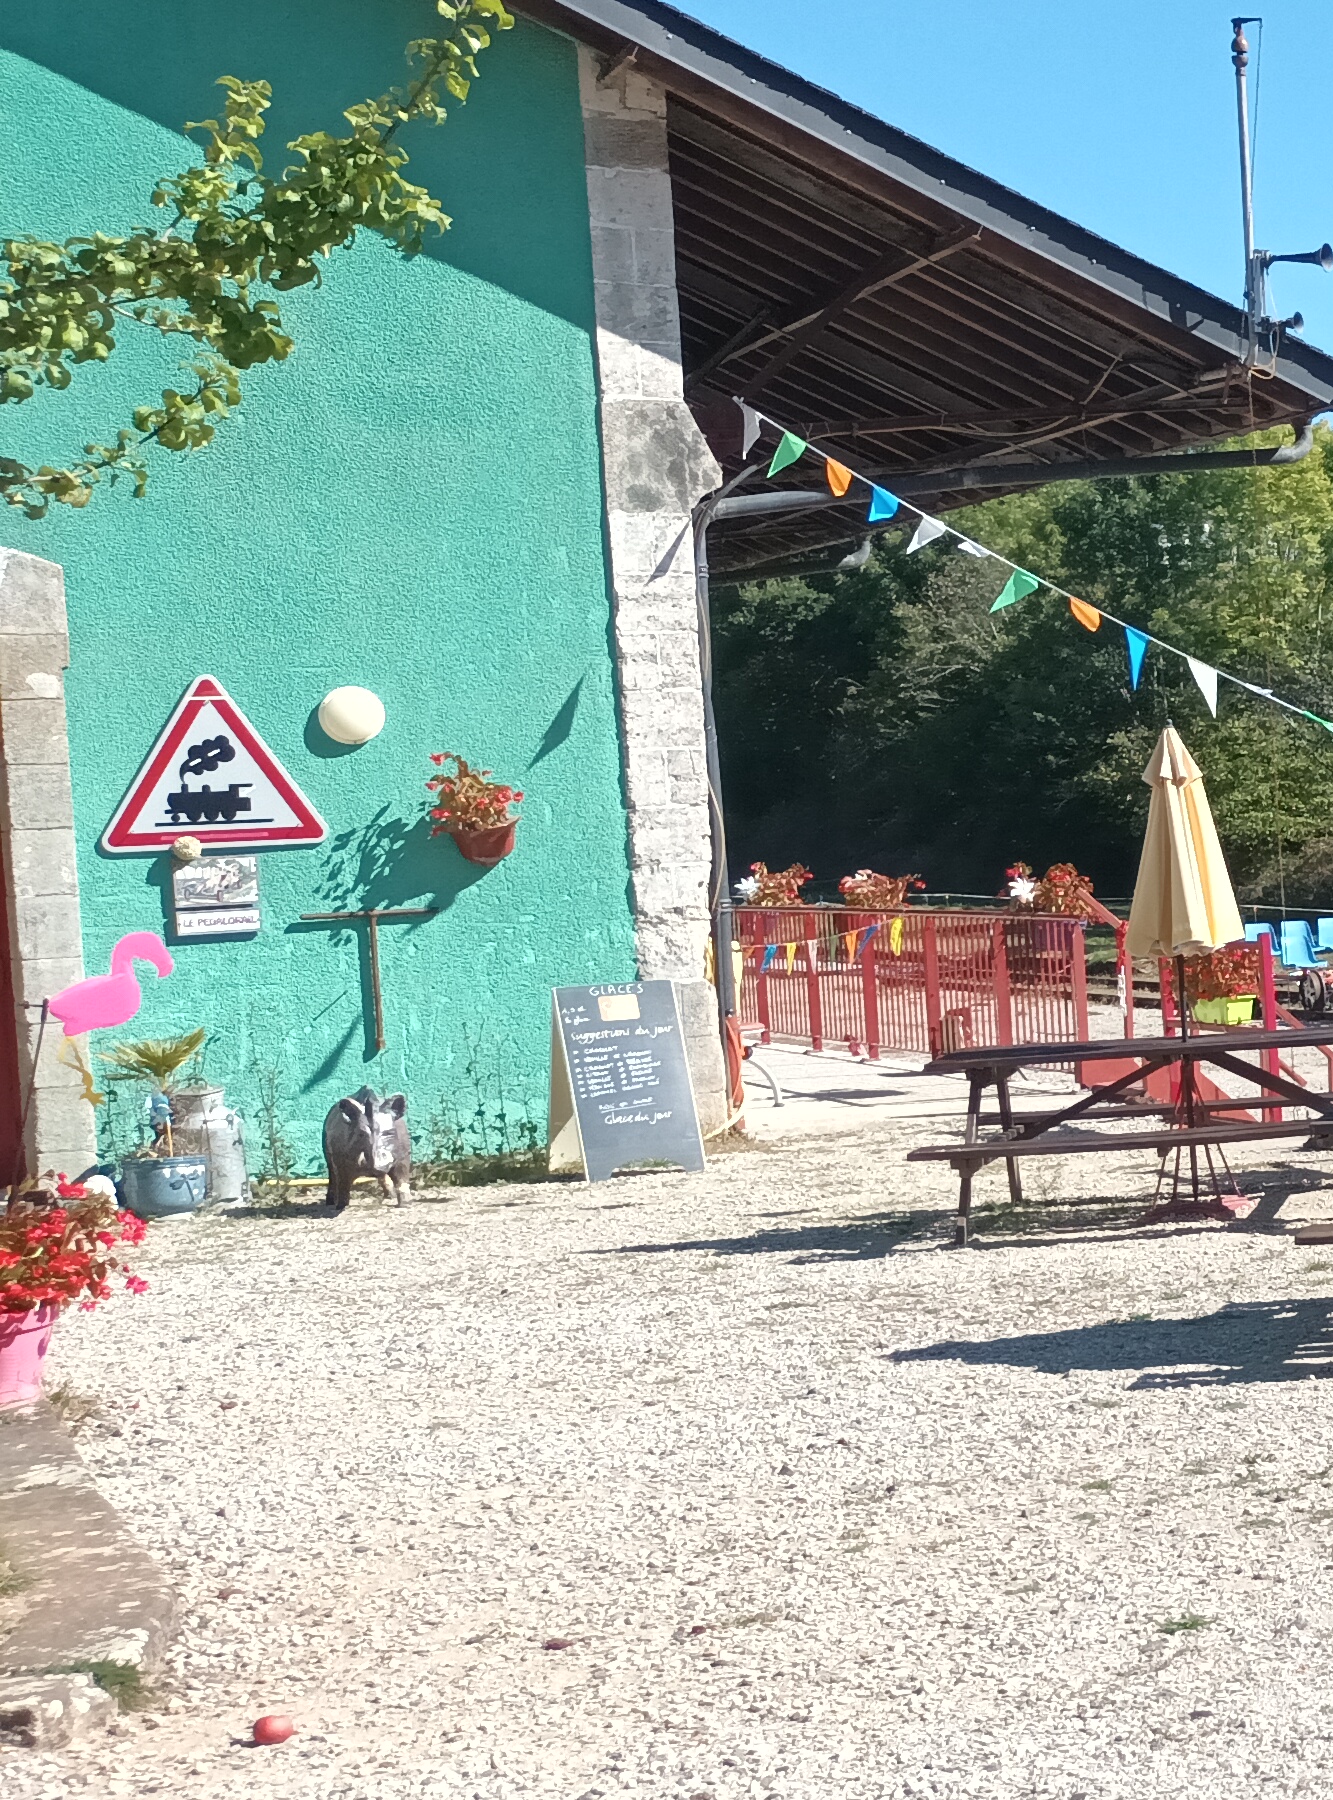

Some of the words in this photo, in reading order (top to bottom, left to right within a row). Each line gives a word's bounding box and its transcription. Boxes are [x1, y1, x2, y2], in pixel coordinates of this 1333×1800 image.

[183, 919, 194, 928] LE
[589, 983, 644, 996] GLACES
[570, 1028, 630, 1045] Suggestions
[634, 1025, 650, 1036] du
[649, 1025, 674, 1039] jour
[604, 1111, 634, 1125] Glace
[633, 1110, 651, 1123] du
[648, 1109, 673, 1125] jour
